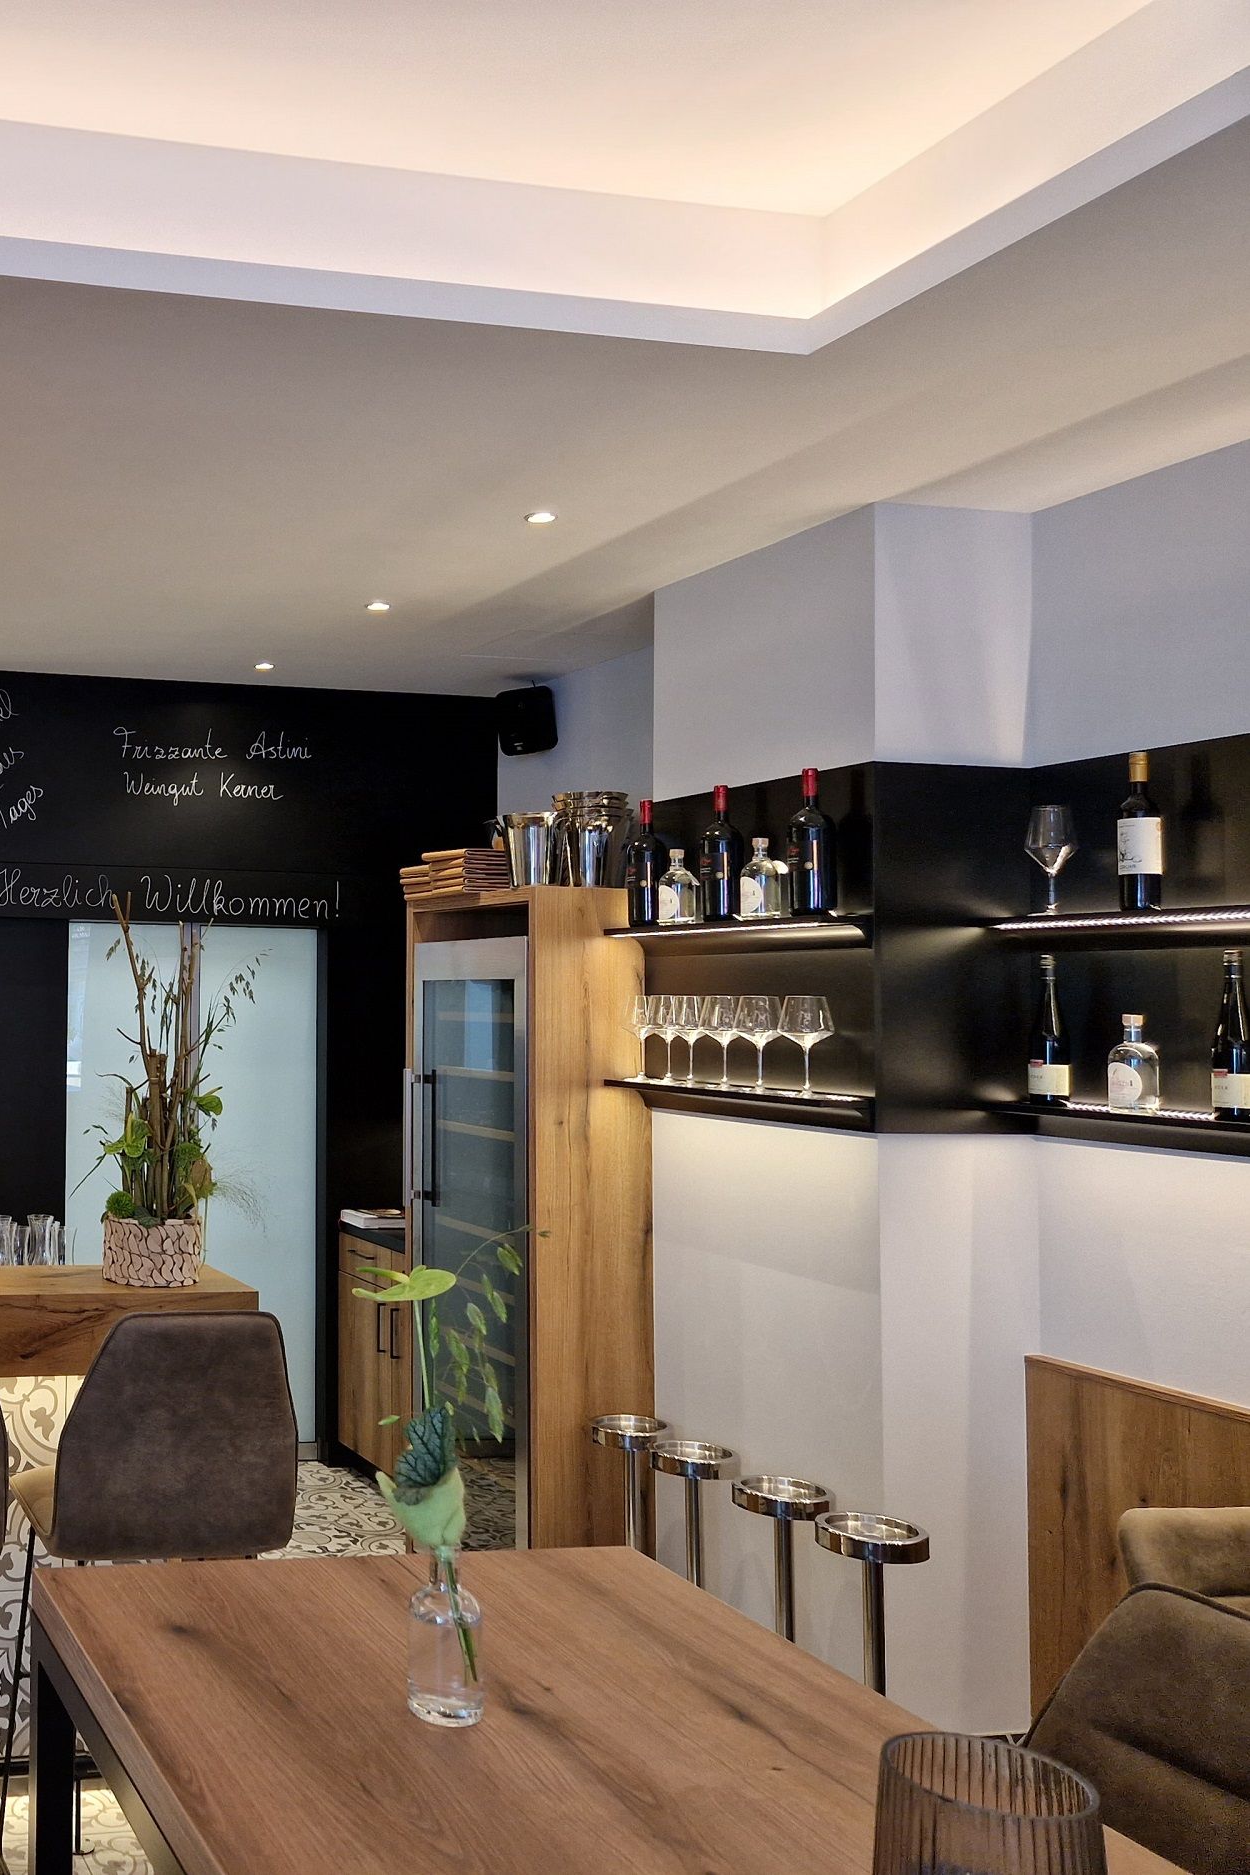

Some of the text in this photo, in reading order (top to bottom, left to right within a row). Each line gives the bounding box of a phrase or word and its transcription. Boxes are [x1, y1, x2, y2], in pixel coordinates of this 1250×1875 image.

[113, 726, 312, 759] Frizzante Astini
[124, 772, 284, 806] Weingut Kerner
[140, 874, 341, 920] Willkommen!
